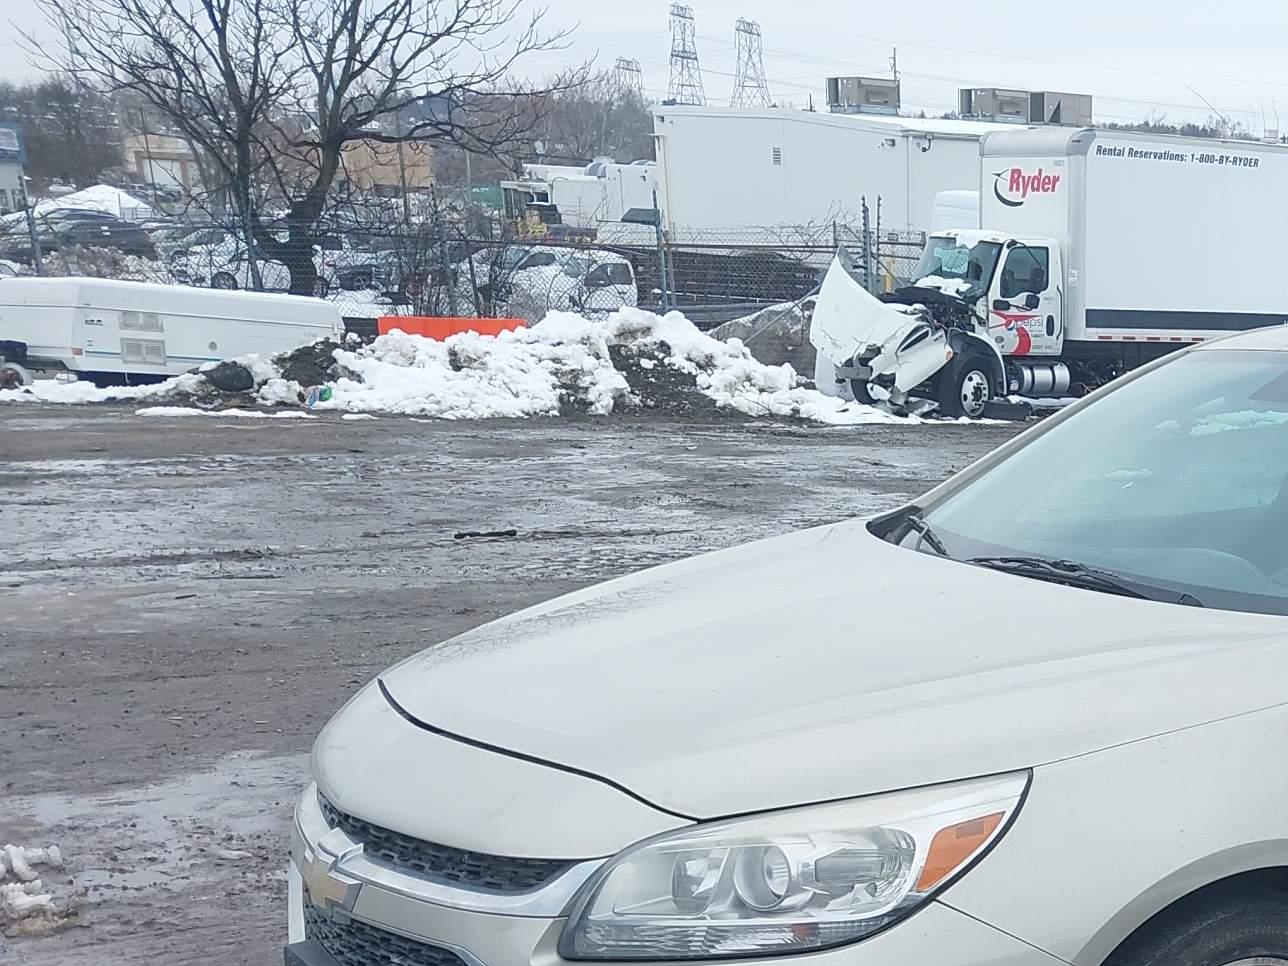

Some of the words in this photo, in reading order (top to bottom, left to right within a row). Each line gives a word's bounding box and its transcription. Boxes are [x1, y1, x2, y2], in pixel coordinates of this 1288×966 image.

[1096, 145, 1125, 157] Rental
[1128, 147, 1187, 162] Reservations:
[1190, 153, 1259, 168] 1-800-BY-RYDER
[1009, 168, 1060, 198] Ryder
[1015, 317, 1044, 328] pepsi
